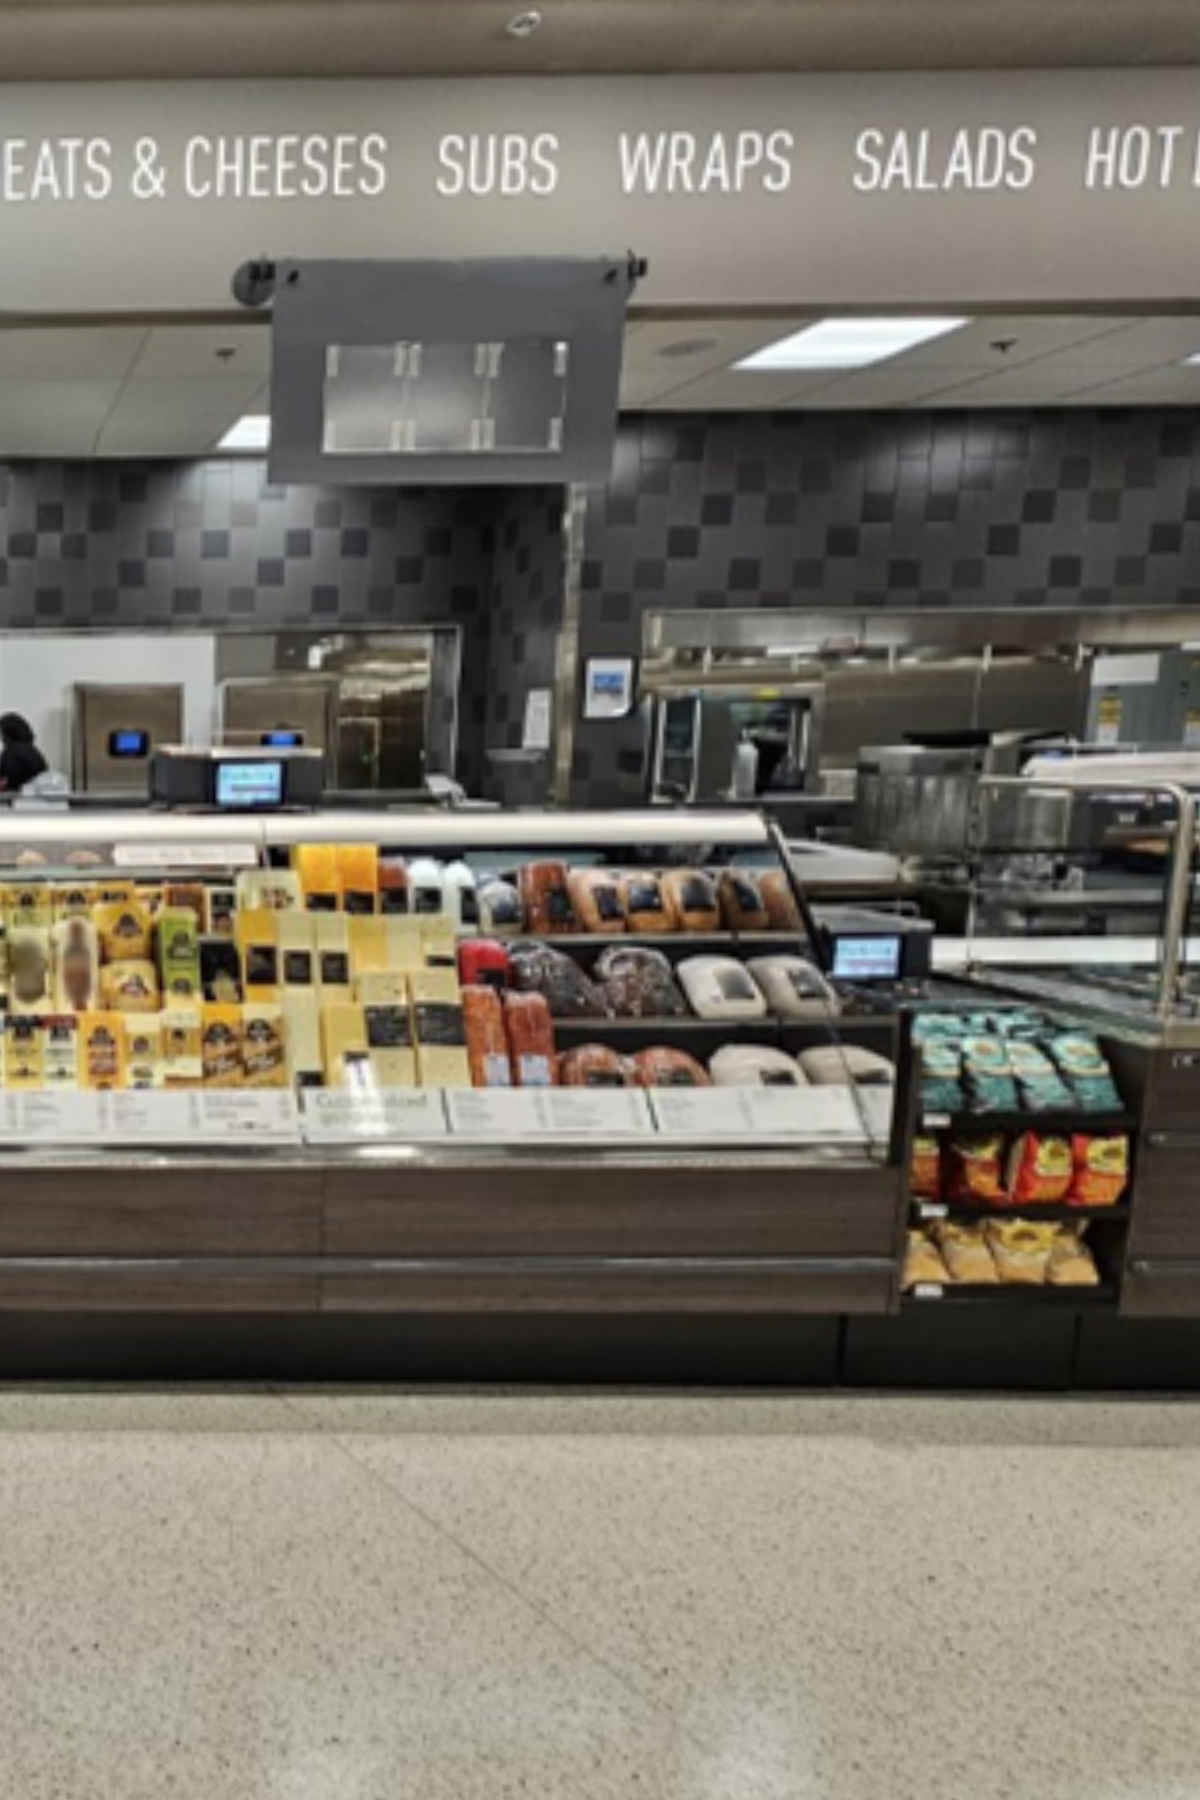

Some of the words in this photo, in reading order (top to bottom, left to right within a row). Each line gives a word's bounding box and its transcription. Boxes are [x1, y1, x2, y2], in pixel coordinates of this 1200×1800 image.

[131, 137, 166, 198] &
[184, 133, 388, 198] CHEESES
[436, 133, 558, 195] SUBS
[620, 130, 794, 193] WRAPS
[853, 127, 1036, 191] SALADS
[1085, 125, 1184, 189] HOT
